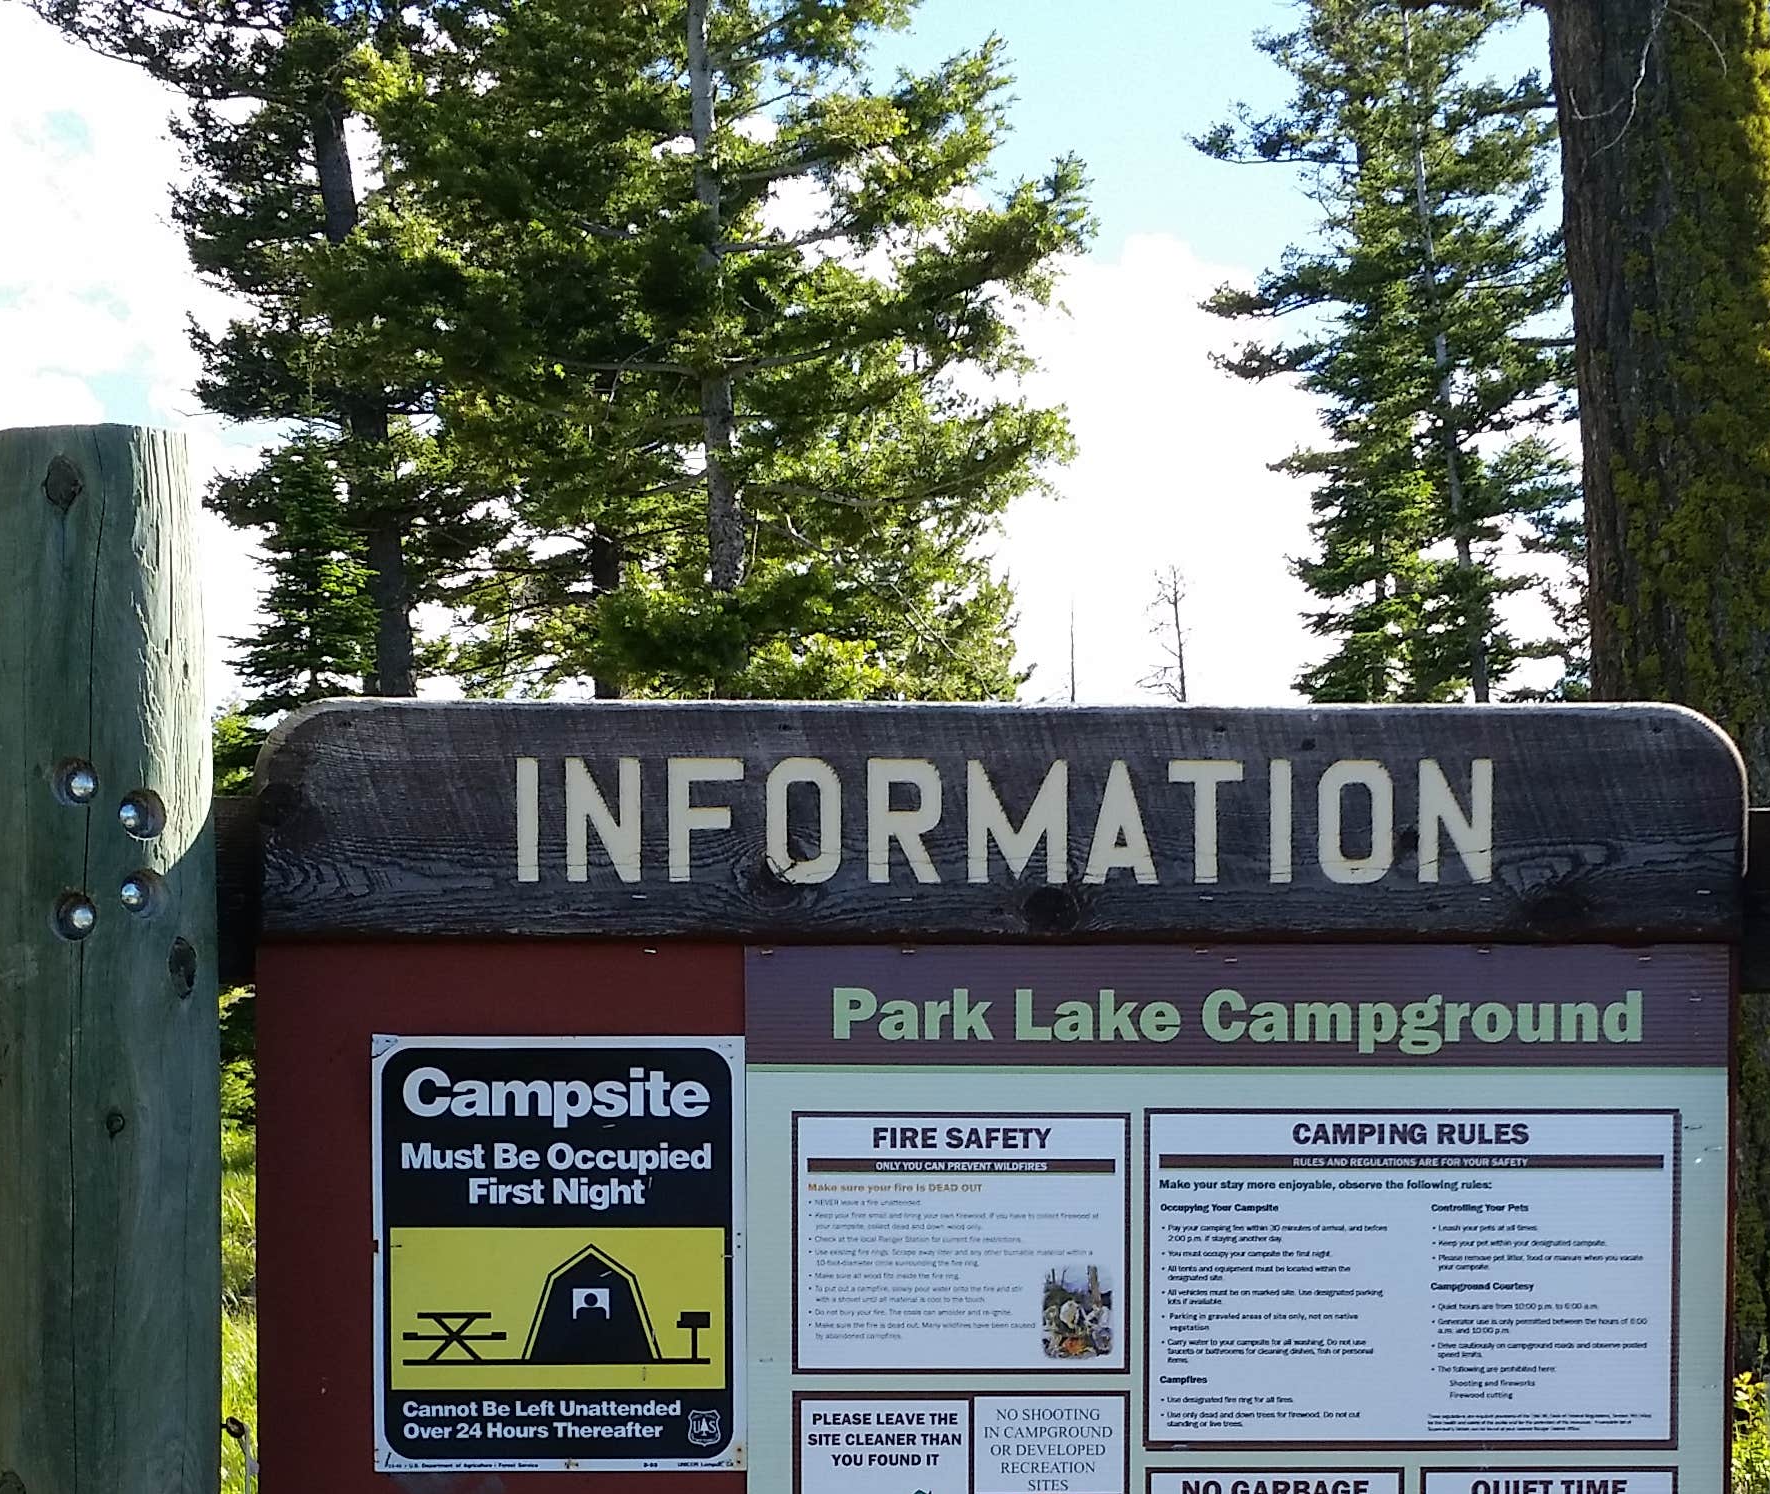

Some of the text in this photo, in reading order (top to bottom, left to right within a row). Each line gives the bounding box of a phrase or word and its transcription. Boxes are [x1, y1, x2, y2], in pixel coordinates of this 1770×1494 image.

[516, 757, 1492, 884] INFORMATION
[834, 988, 1642, 1054] Park Lake Campground
[403, 1067, 710, 1128] Campsite
[874, 1128, 1051, 1148] FIRE SAFETY
[1293, 1123, 1529, 1144] CAMPING RULES
[402, 1143, 711, 1175] Must Be Occupied
[876, 1162, 1047, 1171] ONLY YOU CAN PREVENT WILDFIRES
[469, 1177, 645, 1210] First Night
[403, 1400, 681, 1417] Cannot Be Left Unattended
[997, 1409, 1099, 1420] NO SHOOTING
[813, 1413, 958, 1425] PLEASE LEAVE THE
[404, 1422, 663, 1438] Over 24 Hours Thereafter
[985, 1427, 1112, 1438] IN CAMPGROUND
[808, 1434, 961, 1445] SITE CLEANER THAN
[991, 1445, 1105, 1455] OR DEVELOPED
[831, 1454, 939, 1466] YOU FOUND IT
[1001, 1462, 1094, 1473] RECREATION
[1029, 1480, 1068, 1491] SITES
